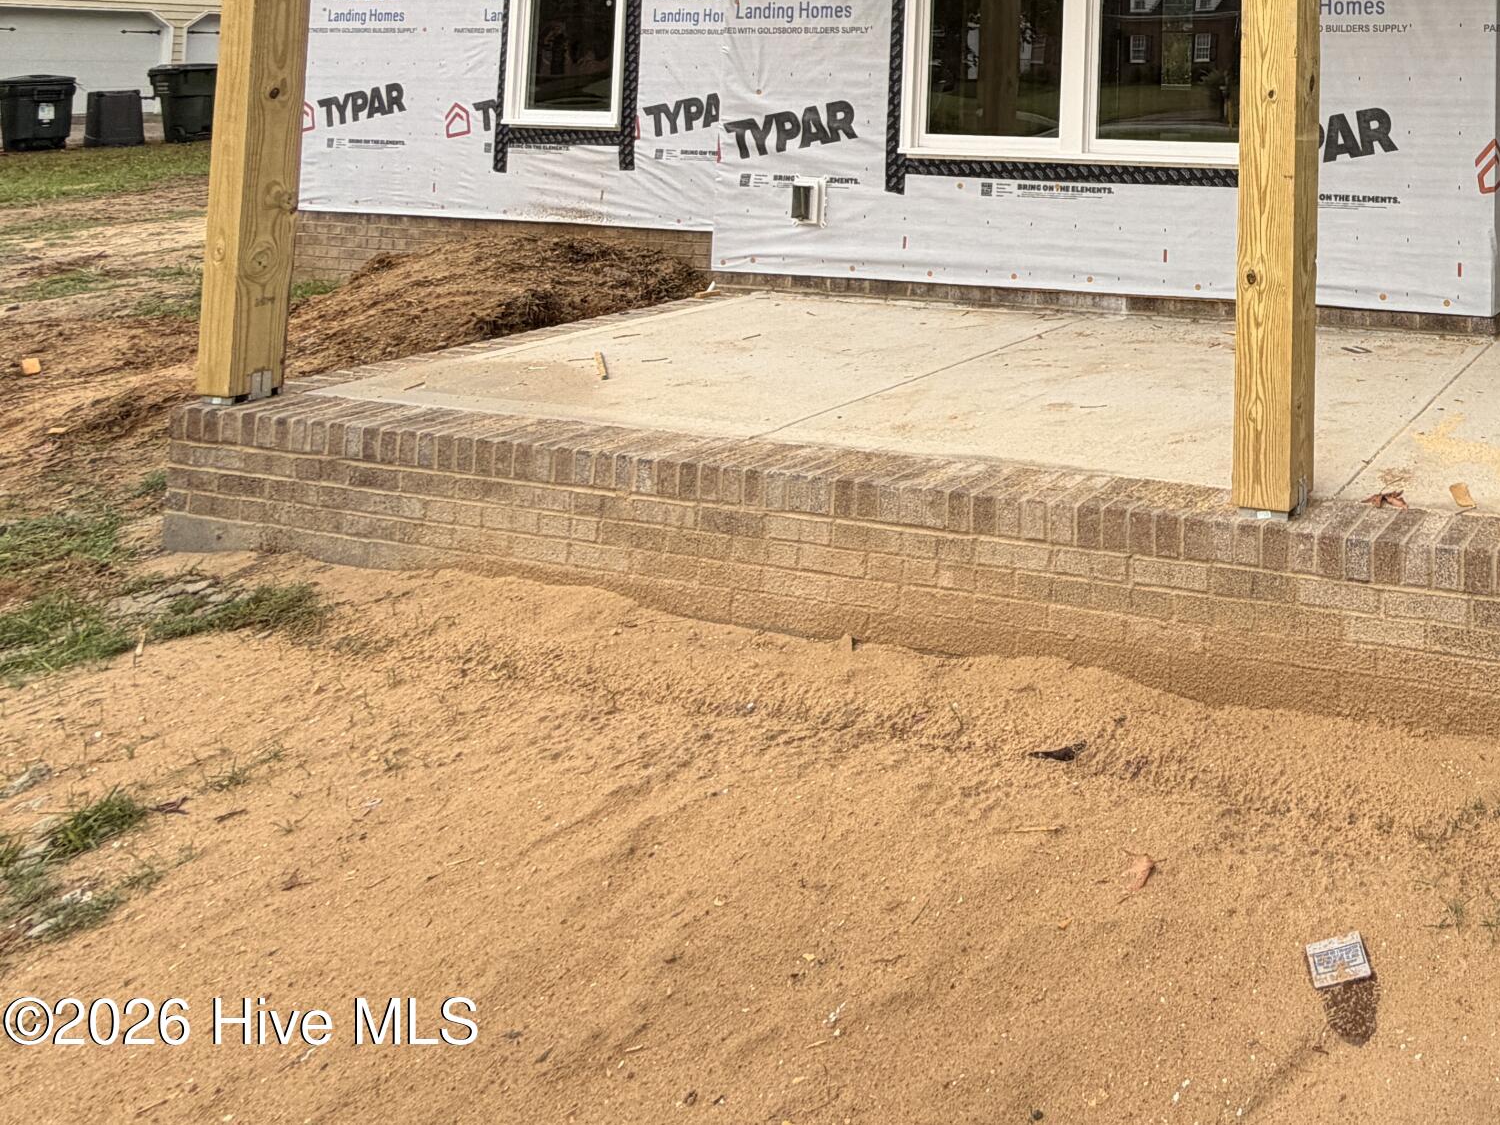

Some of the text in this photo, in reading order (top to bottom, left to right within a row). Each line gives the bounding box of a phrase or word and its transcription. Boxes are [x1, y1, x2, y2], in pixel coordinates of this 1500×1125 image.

[328, 9, 405, 25] Landing Homes
[653, 8, 699, 24] Landing
[735, 2, 794, 23] Landing
[799, 2, 852, 19] Homes
[1325, 24, 1370, 33] BUILDERS
[317, 82, 407, 127] TYPAR
[643, 93, 720, 137] TYPA
[724, 100, 858, 159] TYPAR
[1017, 183, 1041, 191] BRING
[1042, 184, 1054, 192] ON
[1071, 185, 1114, 194] ELEMENTS.
[1319, 193, 1401, 204] ON THE ELEMENTS.
